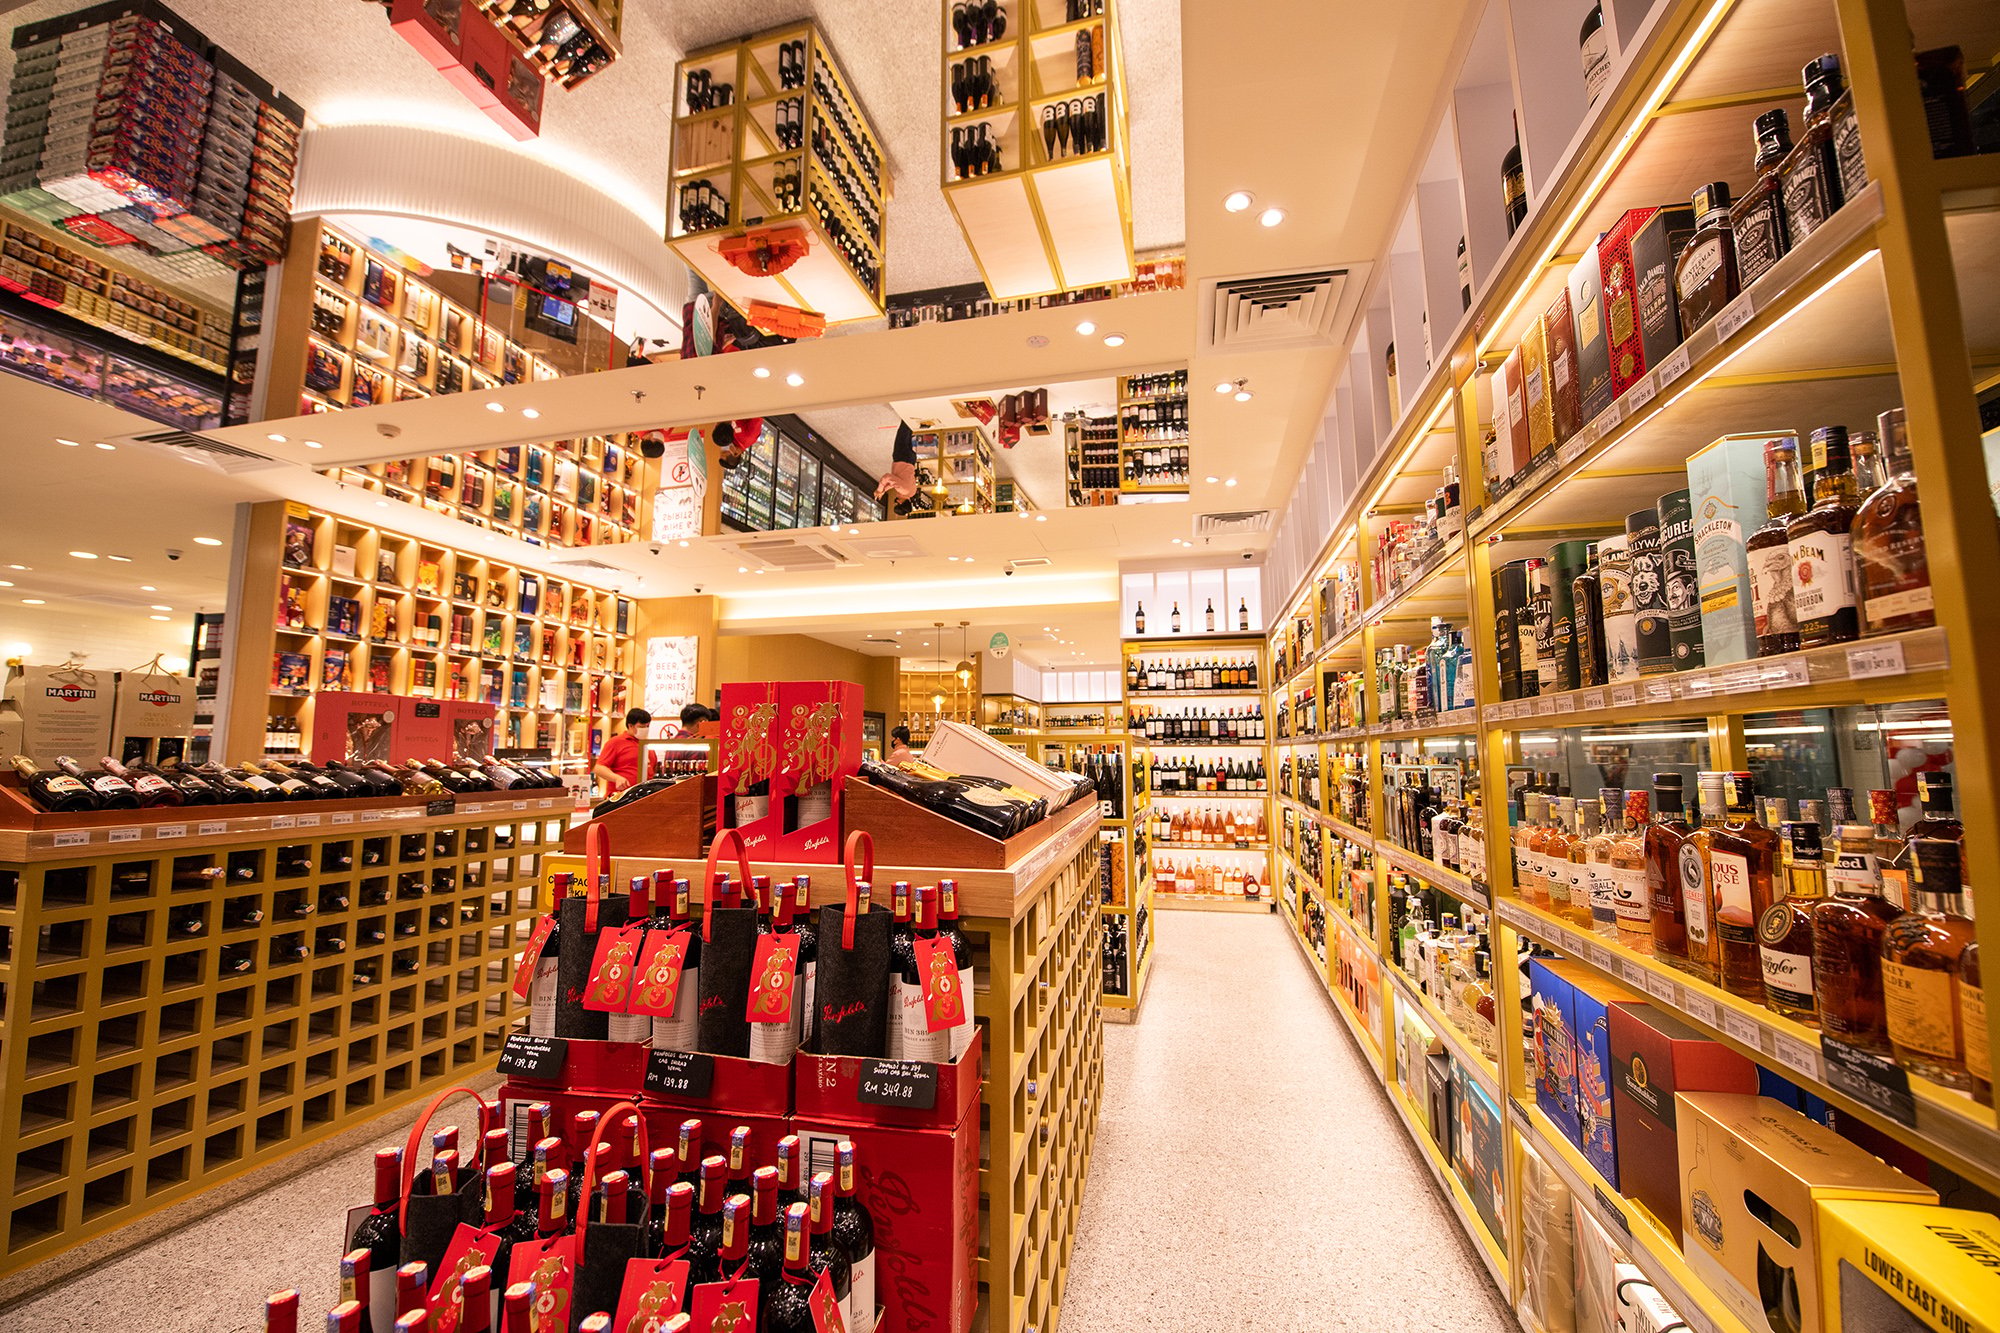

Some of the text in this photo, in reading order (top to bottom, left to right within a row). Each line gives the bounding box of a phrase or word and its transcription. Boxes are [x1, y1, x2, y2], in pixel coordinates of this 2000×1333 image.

[1746, 206, 1773, 230] DANIEL'S
[1681, 245, 1716, 284] GENTLEMAN
[1691, 264, 1706, 281] JACK
[1694, 520, 1733, 545] SHACKLETON
[1799, 545, 1825, 561] BEAM
[1795, 593, 1824, 609] BOURBON
[655, 662, 680, 671] BEER,
[47, 688, 95, 698] MARTINI
[655, 682, 685, 691] SPIRITS
[140, 693, 180, 703] MARTINI
[351, 700, 390, 708] BOTTEGA
[405, 735, 439, 743] BOTTEGA
[804, 836, 829, 850] Penfolds
[823, 999, 866, 1024] Penfolds
[501, 1053, 538, 1070] RM 139.88
[647, 1071, 689, 1090] RM 139.88
[826, 1079, 837, 1087] 2
[863, 1081, 913, 1098] RM 349.88
[1864, 1247, 1905, 1293] LOWER
[1906, 1279, 1938, 1317] EAST
